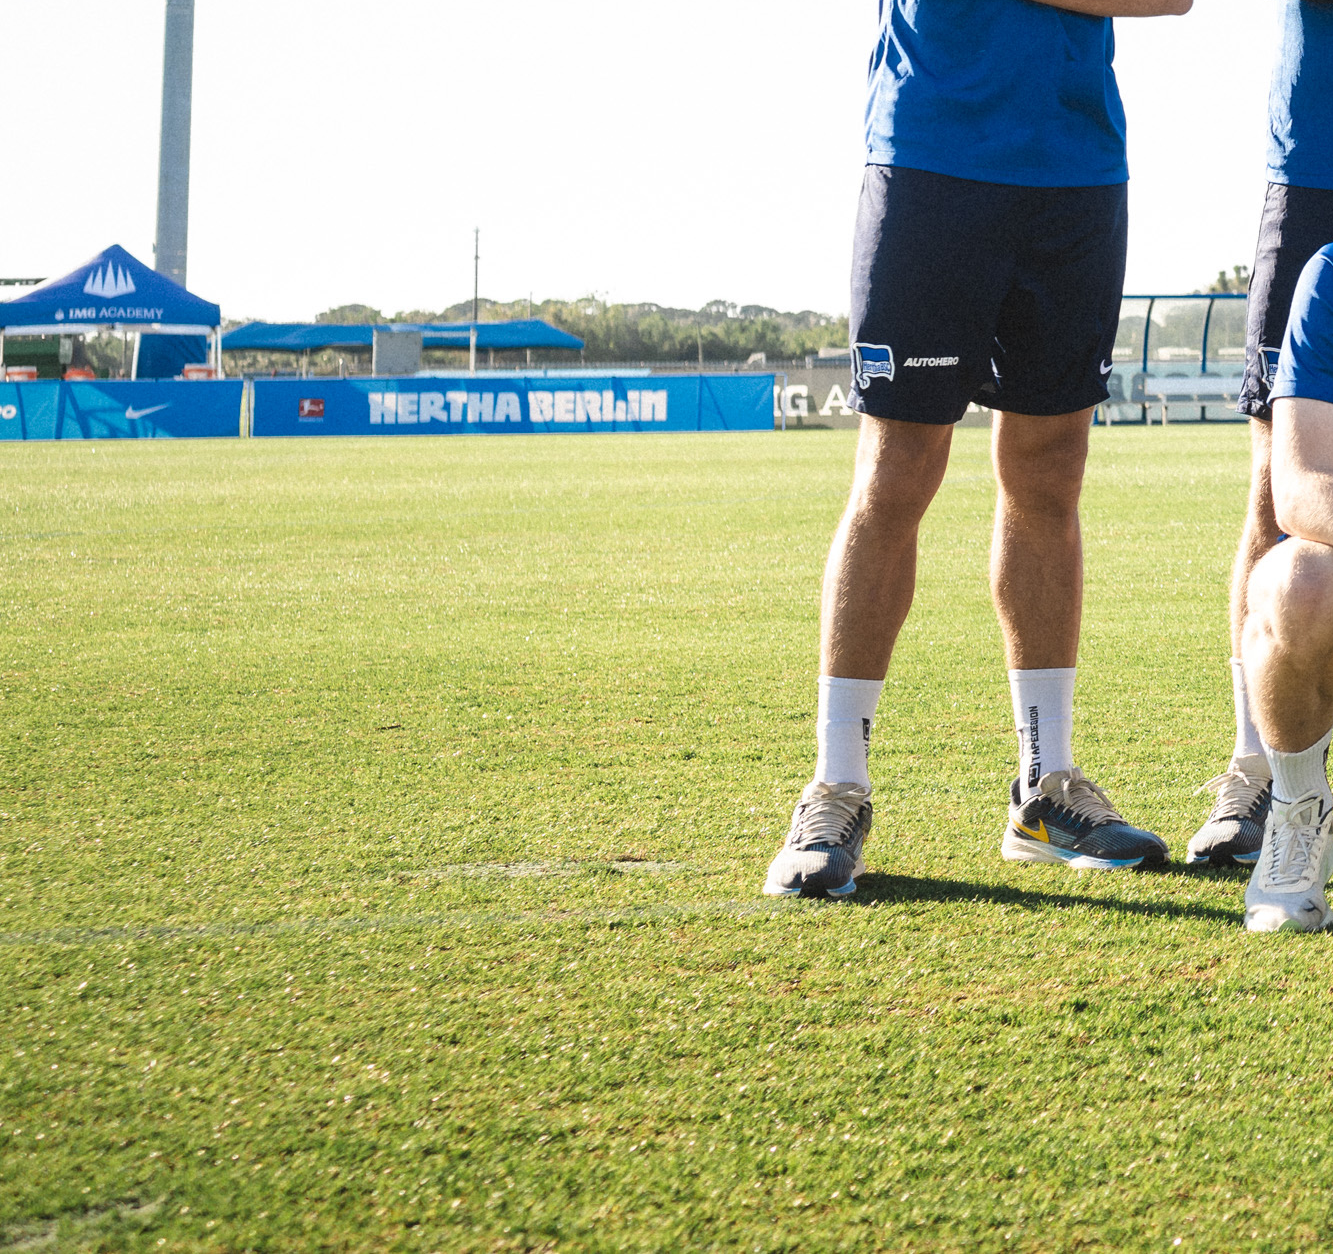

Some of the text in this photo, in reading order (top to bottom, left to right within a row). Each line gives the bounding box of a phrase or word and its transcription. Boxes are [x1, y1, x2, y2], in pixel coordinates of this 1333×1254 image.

[69, 306, 164, 319] IMG ACADEMY
[903, 356, 959, 366] AUTOHERO
[368, 389, 668, 425] HERTHA BERLIN
